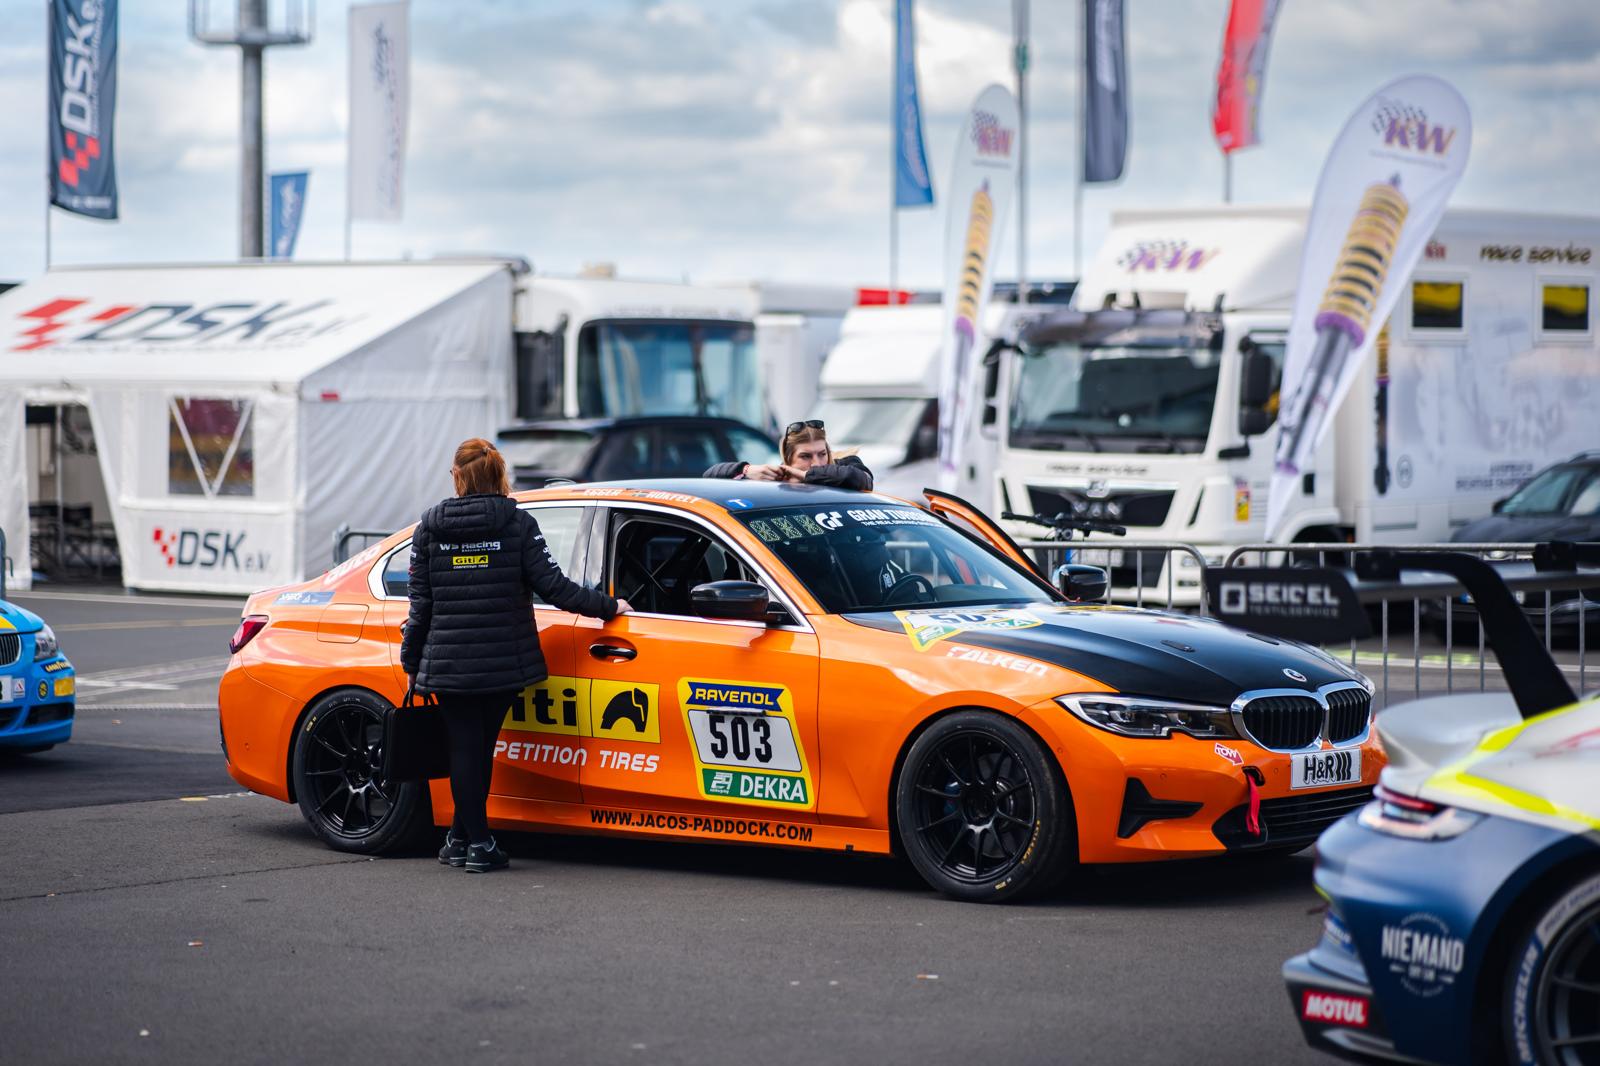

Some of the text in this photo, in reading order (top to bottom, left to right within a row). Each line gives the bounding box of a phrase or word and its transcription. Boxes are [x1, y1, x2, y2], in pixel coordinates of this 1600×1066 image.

[61, 13, 95, 136] DSK
[74, 299, 336, 342] DSK
[846, 509, 889, 522] GRAN
[178, 530, 246, 567] DSK
[455, 557, 476, 565] Giti
[461, 541, 501, 551] Racing
[946, 645, 1049, 677] FALKEN
[508, 687, 577, 726] iti
[695, 688, 774, 706] RAVENOL
[708, 714, 773, 763] 503
[493, 740, 660, 773] PETITION TIRES
[739, 774, 805, 802] DEKRA
[590, 809, 813, 842] WWW.JACOS-PADDOCK.COM
[1381, 924, 1465, 973] NIEMAND
[1306, 995, 1364, 1024] MOTUL
